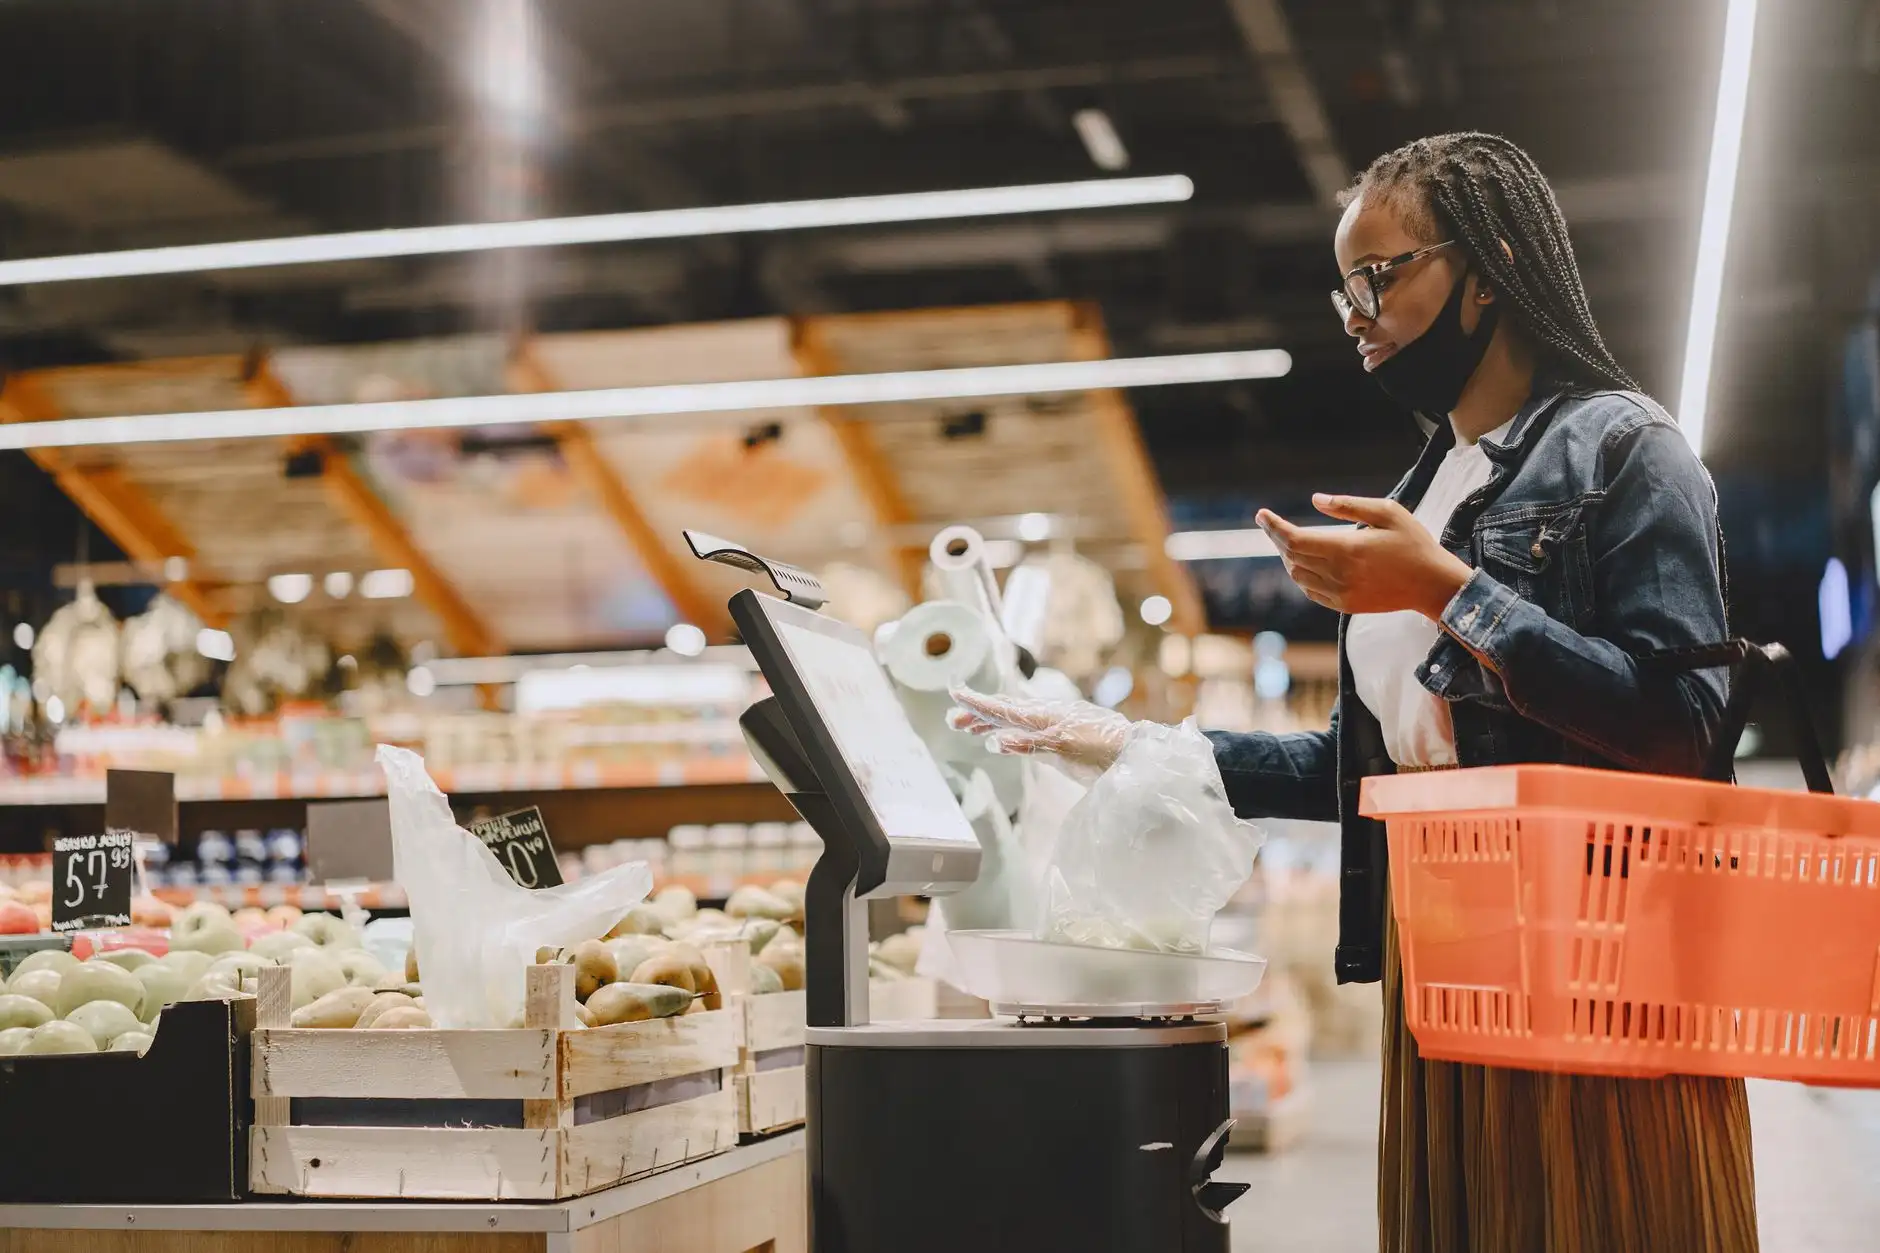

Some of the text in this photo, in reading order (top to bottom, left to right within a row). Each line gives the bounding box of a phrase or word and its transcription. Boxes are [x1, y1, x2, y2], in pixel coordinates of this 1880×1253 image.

[480, 817, 541, 844] ФЕРЕНЦІЯ
[64, 846, 130, 908] 57 99
